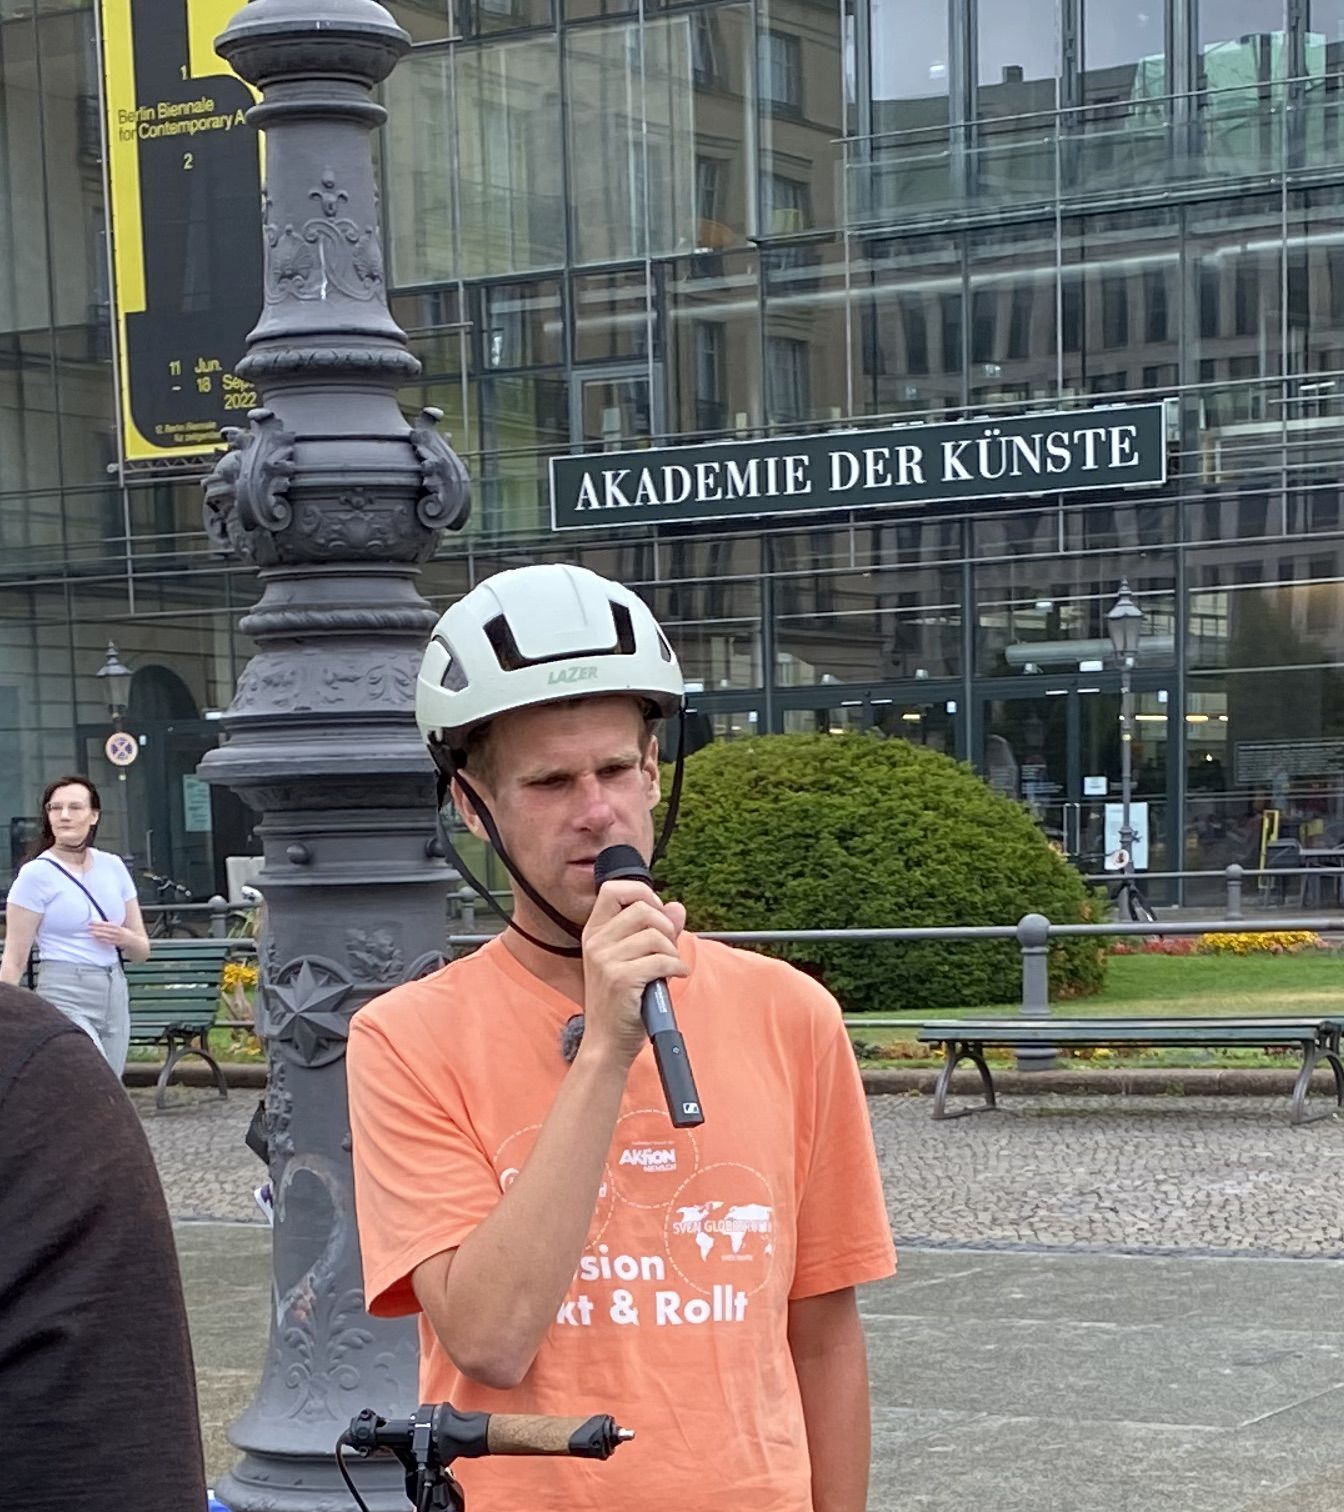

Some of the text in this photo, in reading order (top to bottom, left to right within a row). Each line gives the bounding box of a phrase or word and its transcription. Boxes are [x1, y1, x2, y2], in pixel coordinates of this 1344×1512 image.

[118, 96, 215, 124] Berlin Biennale
[119, 109, 247, 141] for Contemporary A
[183, 153, 194, 169] 2
[169, 357, 223, 376] 11 Jun.
[224, 392, 257, 410] 2022
[574, 424, 1141, 511] AKADEMIE DER KÜNSTE
[547, 666, 599, 685] LAZER
[609, 1288, 640, 1327] &
[656, 1284, 749, 1326] Rollt
